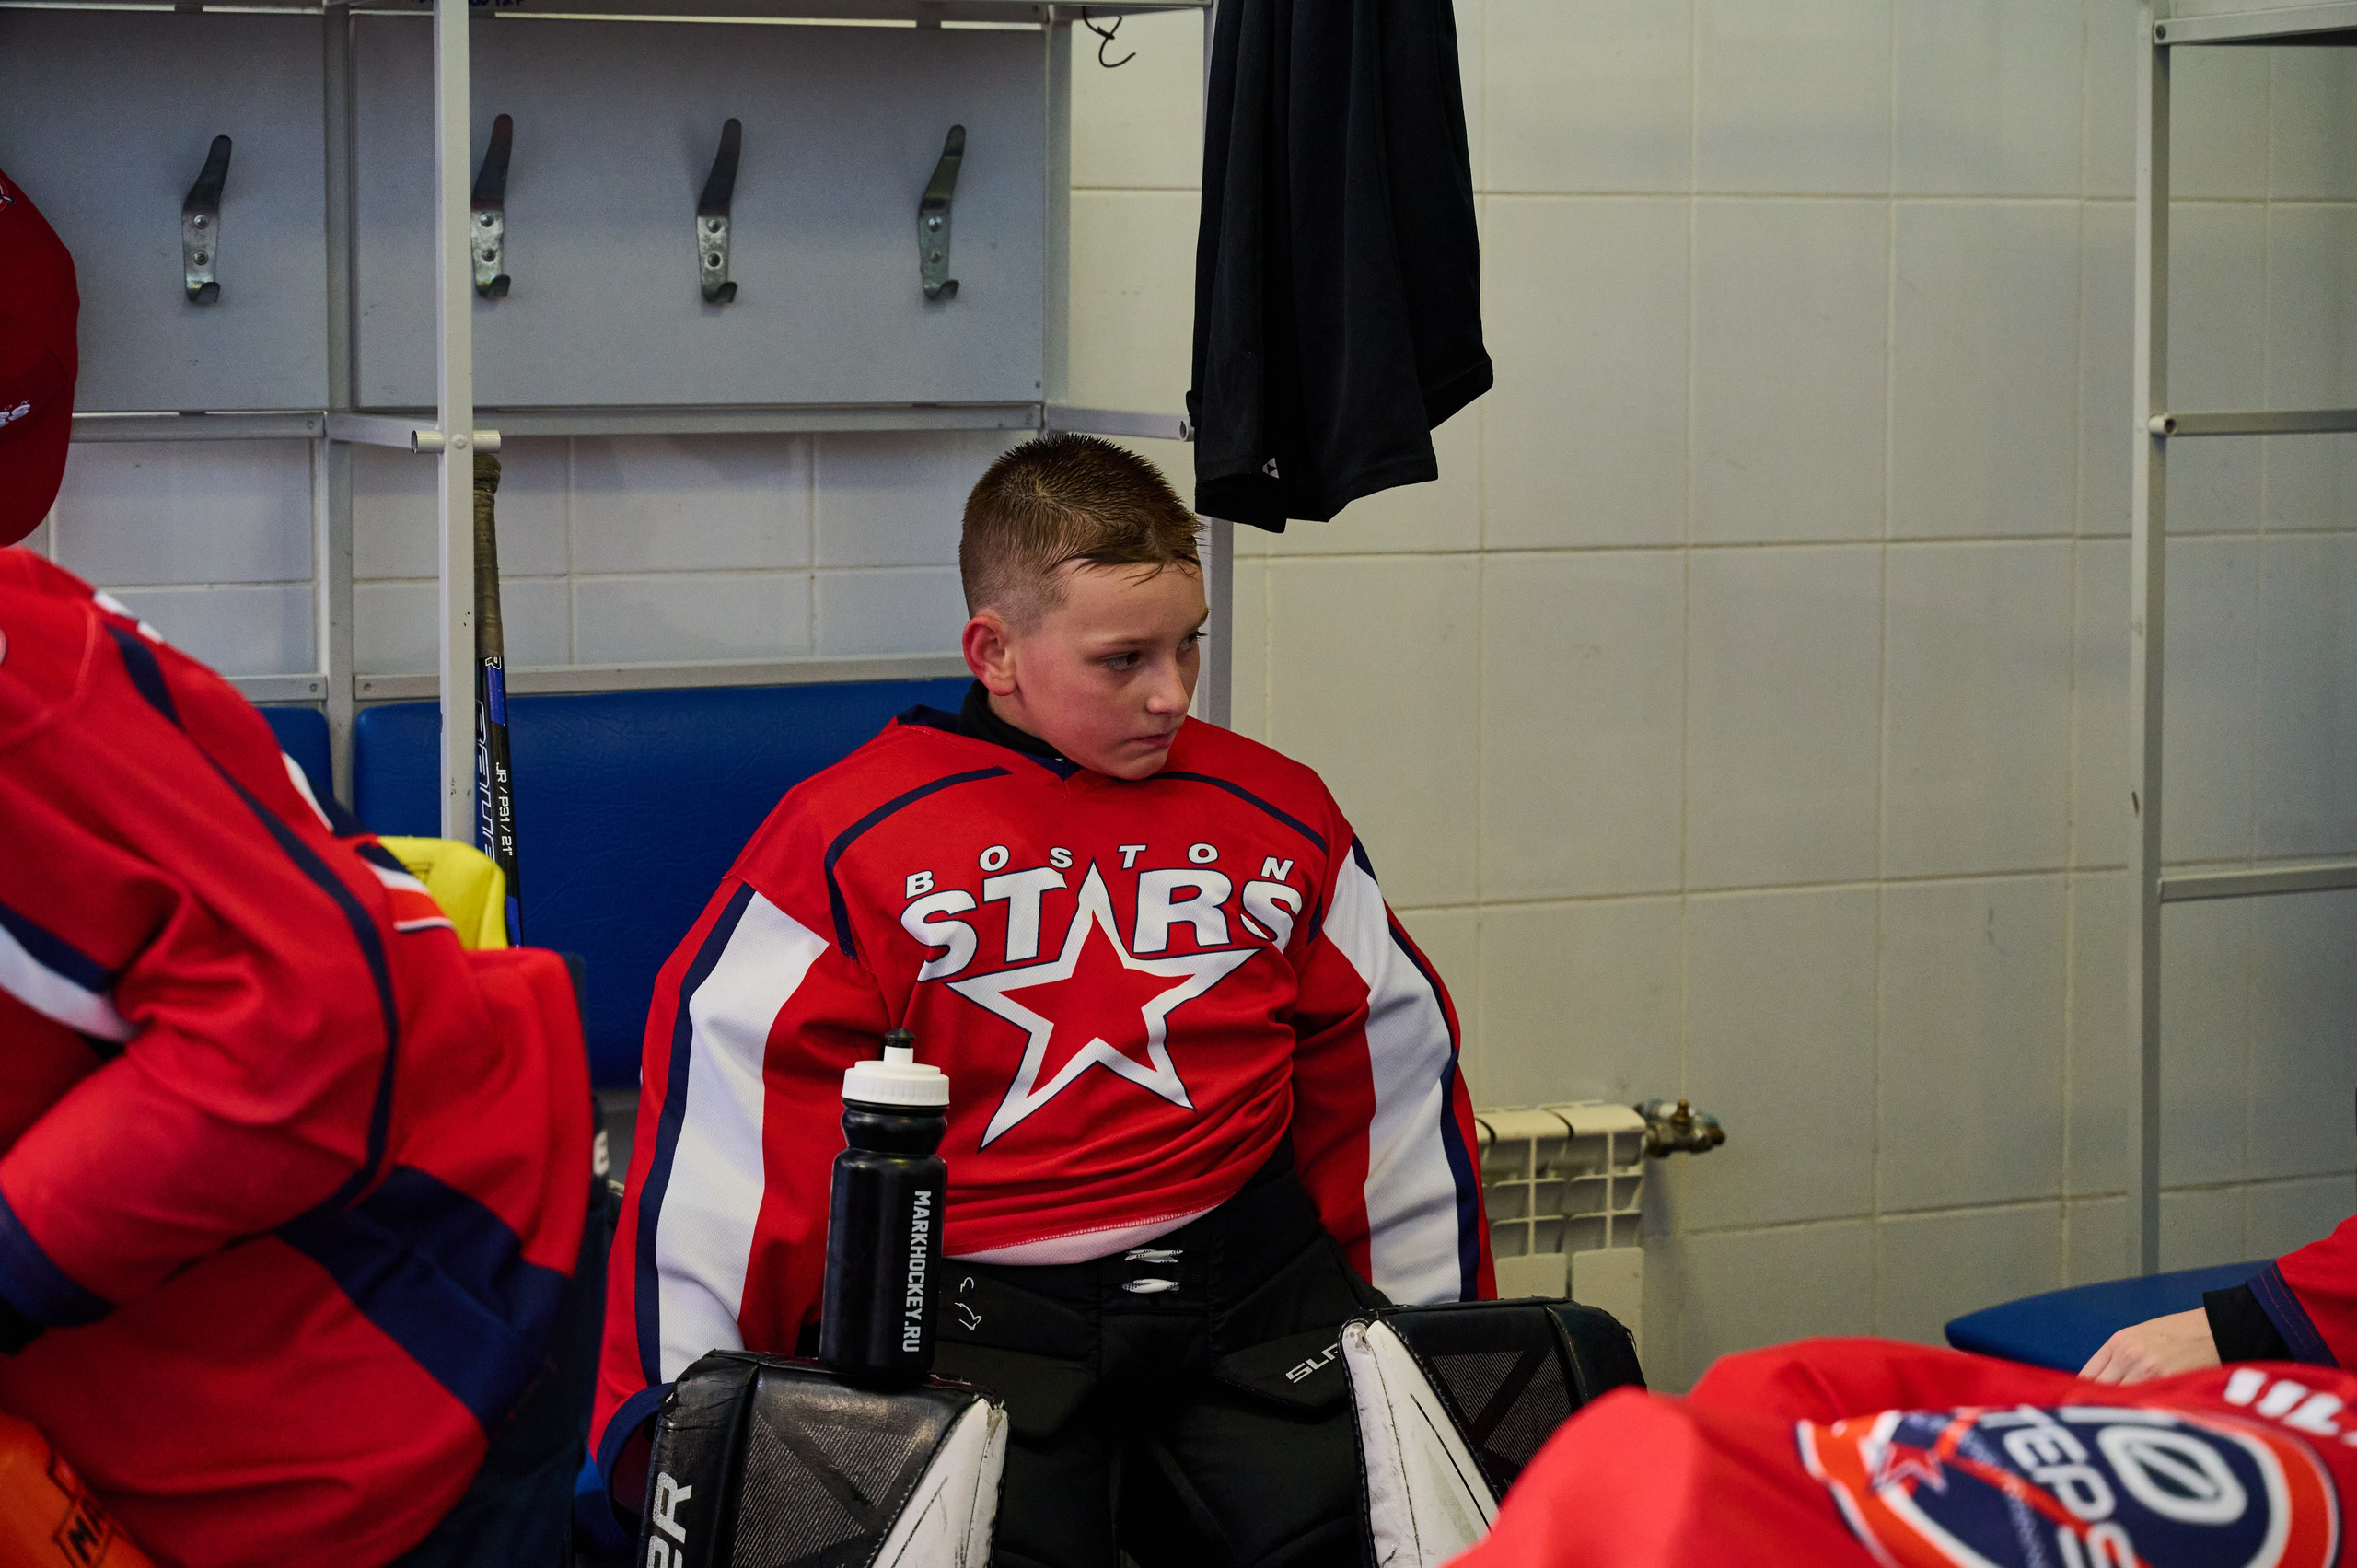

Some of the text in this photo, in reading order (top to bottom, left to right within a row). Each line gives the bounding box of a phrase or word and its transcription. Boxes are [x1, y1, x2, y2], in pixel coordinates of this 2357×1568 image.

[495, 762, 507, 783] JR
[905, 842, 1294, 899] BOSTON
[900, 856, 1303, 982] STARS
[902, 1191, 932, 1353] MARKHOCKEY.RU
